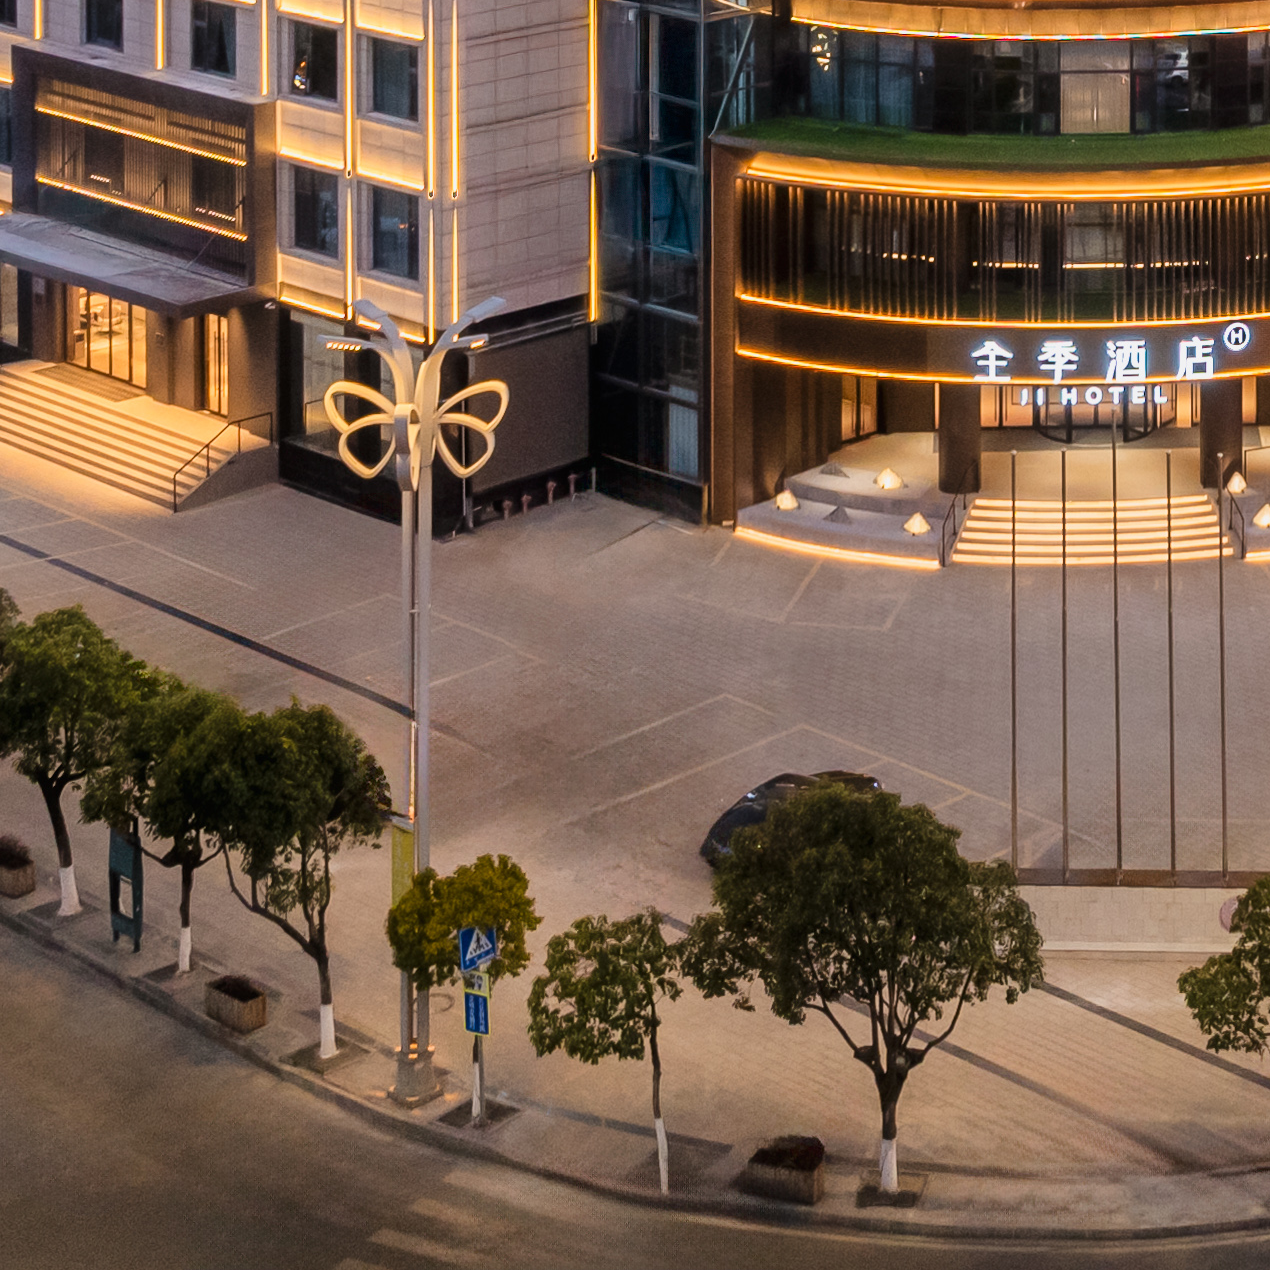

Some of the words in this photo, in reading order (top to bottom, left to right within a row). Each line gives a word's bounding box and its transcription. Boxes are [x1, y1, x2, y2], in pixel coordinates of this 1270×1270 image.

[971, 337, 1215, 385] 全季酒店
[1020, 387, 1044, 407] JI
[1060, 384, 1168, 406] HOTEL
